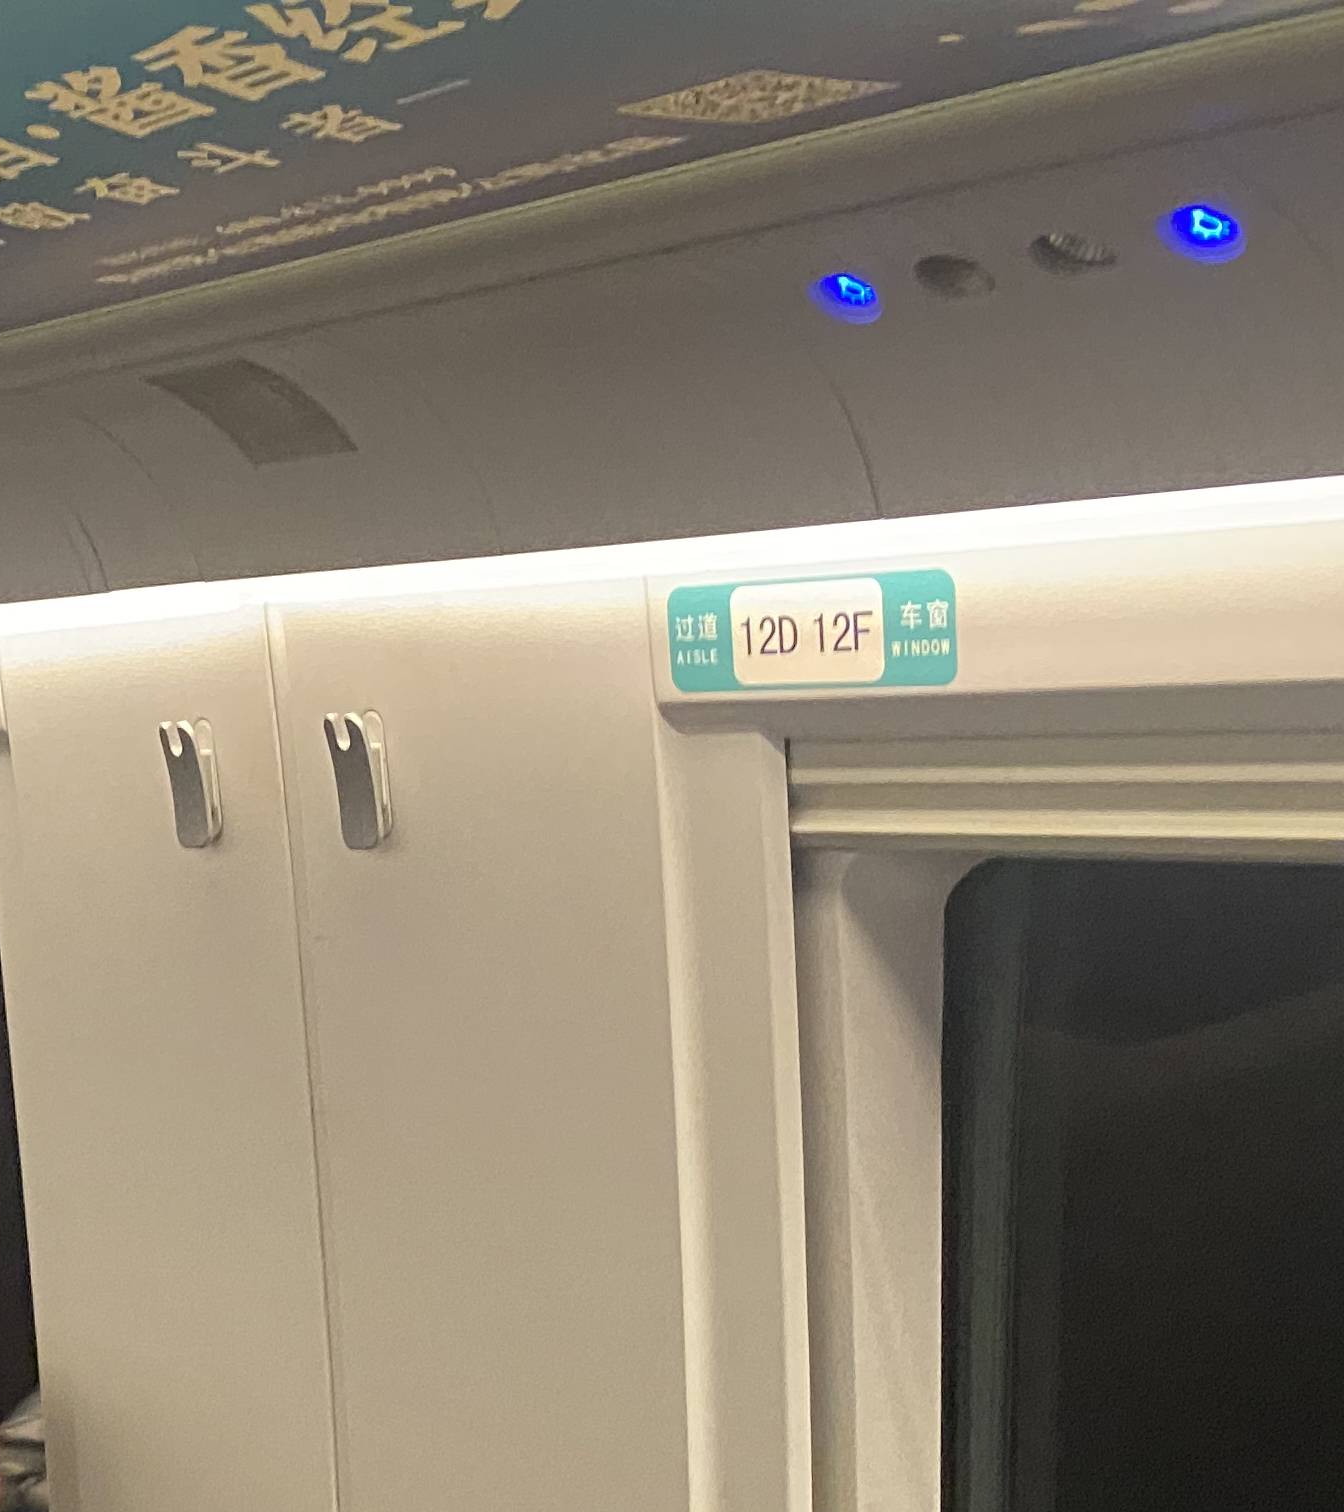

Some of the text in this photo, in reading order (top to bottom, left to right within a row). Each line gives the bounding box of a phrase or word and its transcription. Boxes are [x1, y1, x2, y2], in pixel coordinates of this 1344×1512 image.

[675, 612, 718, 641] 过道
[899, 599, 949, 630] 车窗
[740, 610, 873, 656] 12D 12F
[891, 637, 951, 657] WINDOW
[676, 647, 719, 665] AISLE
